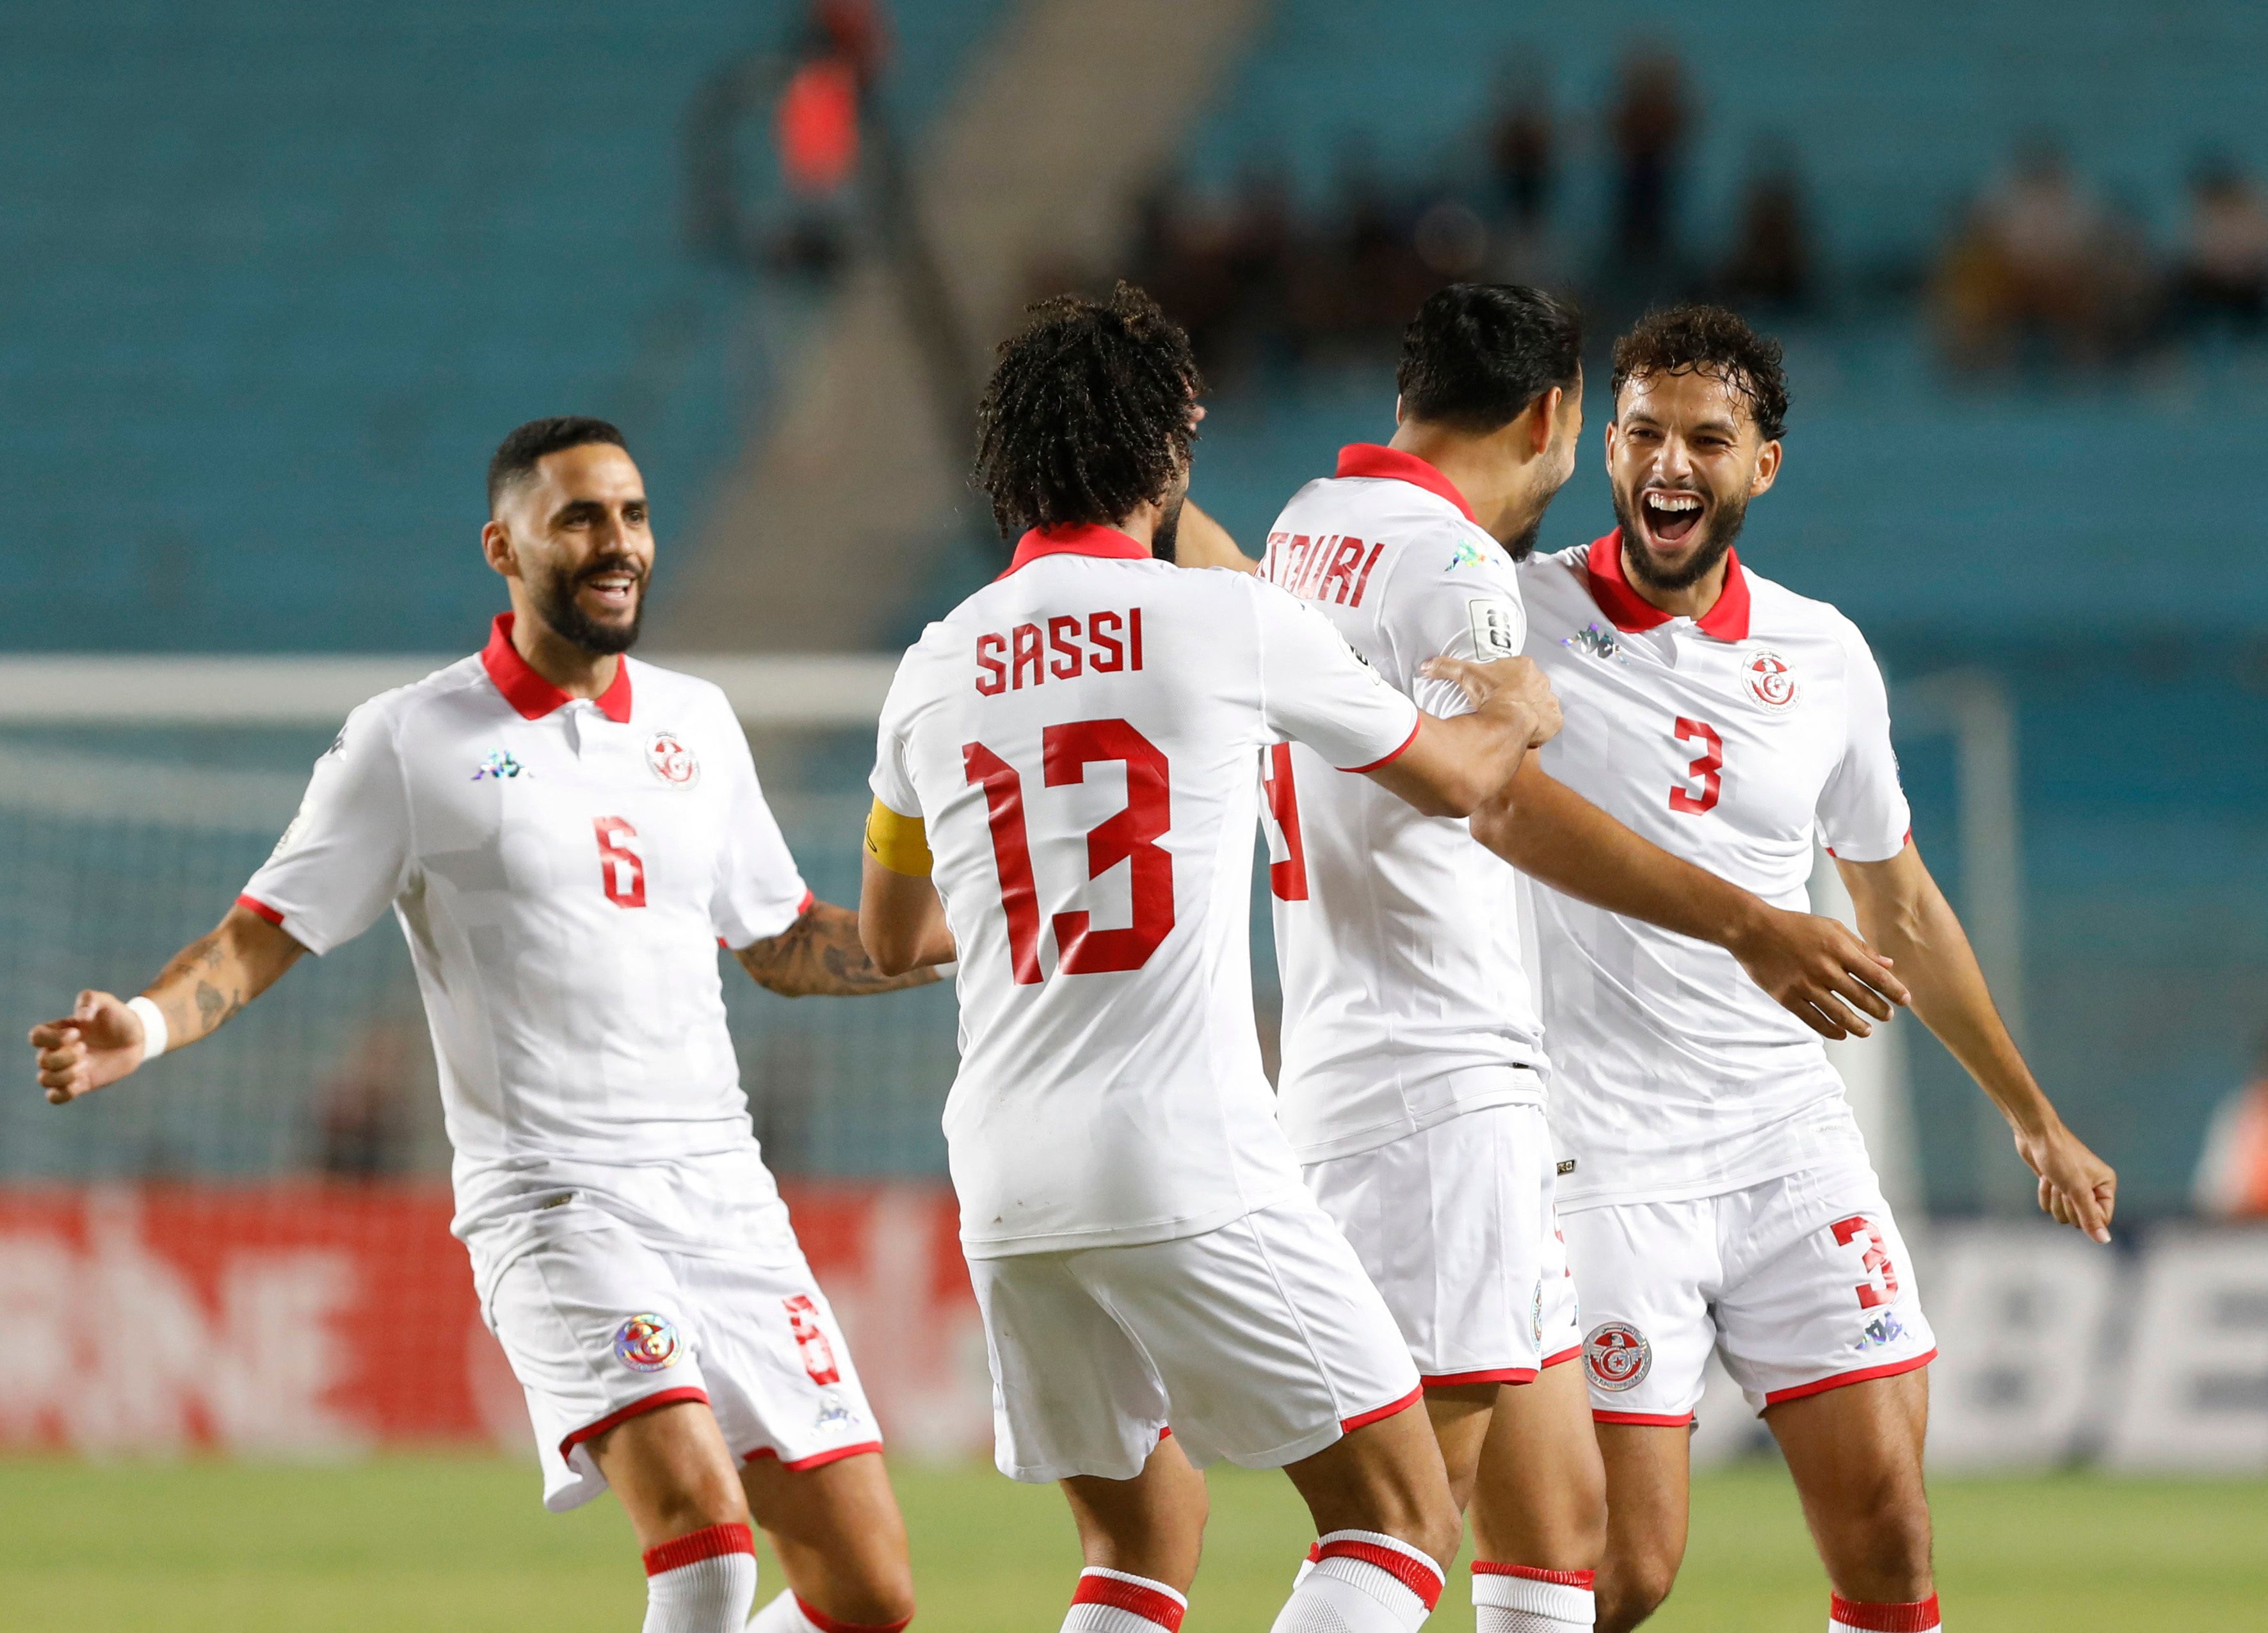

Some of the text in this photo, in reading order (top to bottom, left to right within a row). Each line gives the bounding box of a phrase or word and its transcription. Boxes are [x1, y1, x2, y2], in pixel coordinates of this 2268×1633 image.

[1253, 532, 1386, 608] TOURI
[976, 607, 1143, 696] SASSI
[1669, 716, 1723, 816] 3
[593, 816, 647, 909] 6
[962, 718, 1175, 986] 13
[1830, 1216, 1899, 1309] 3
[782, 1294, 840, 1385] 6
